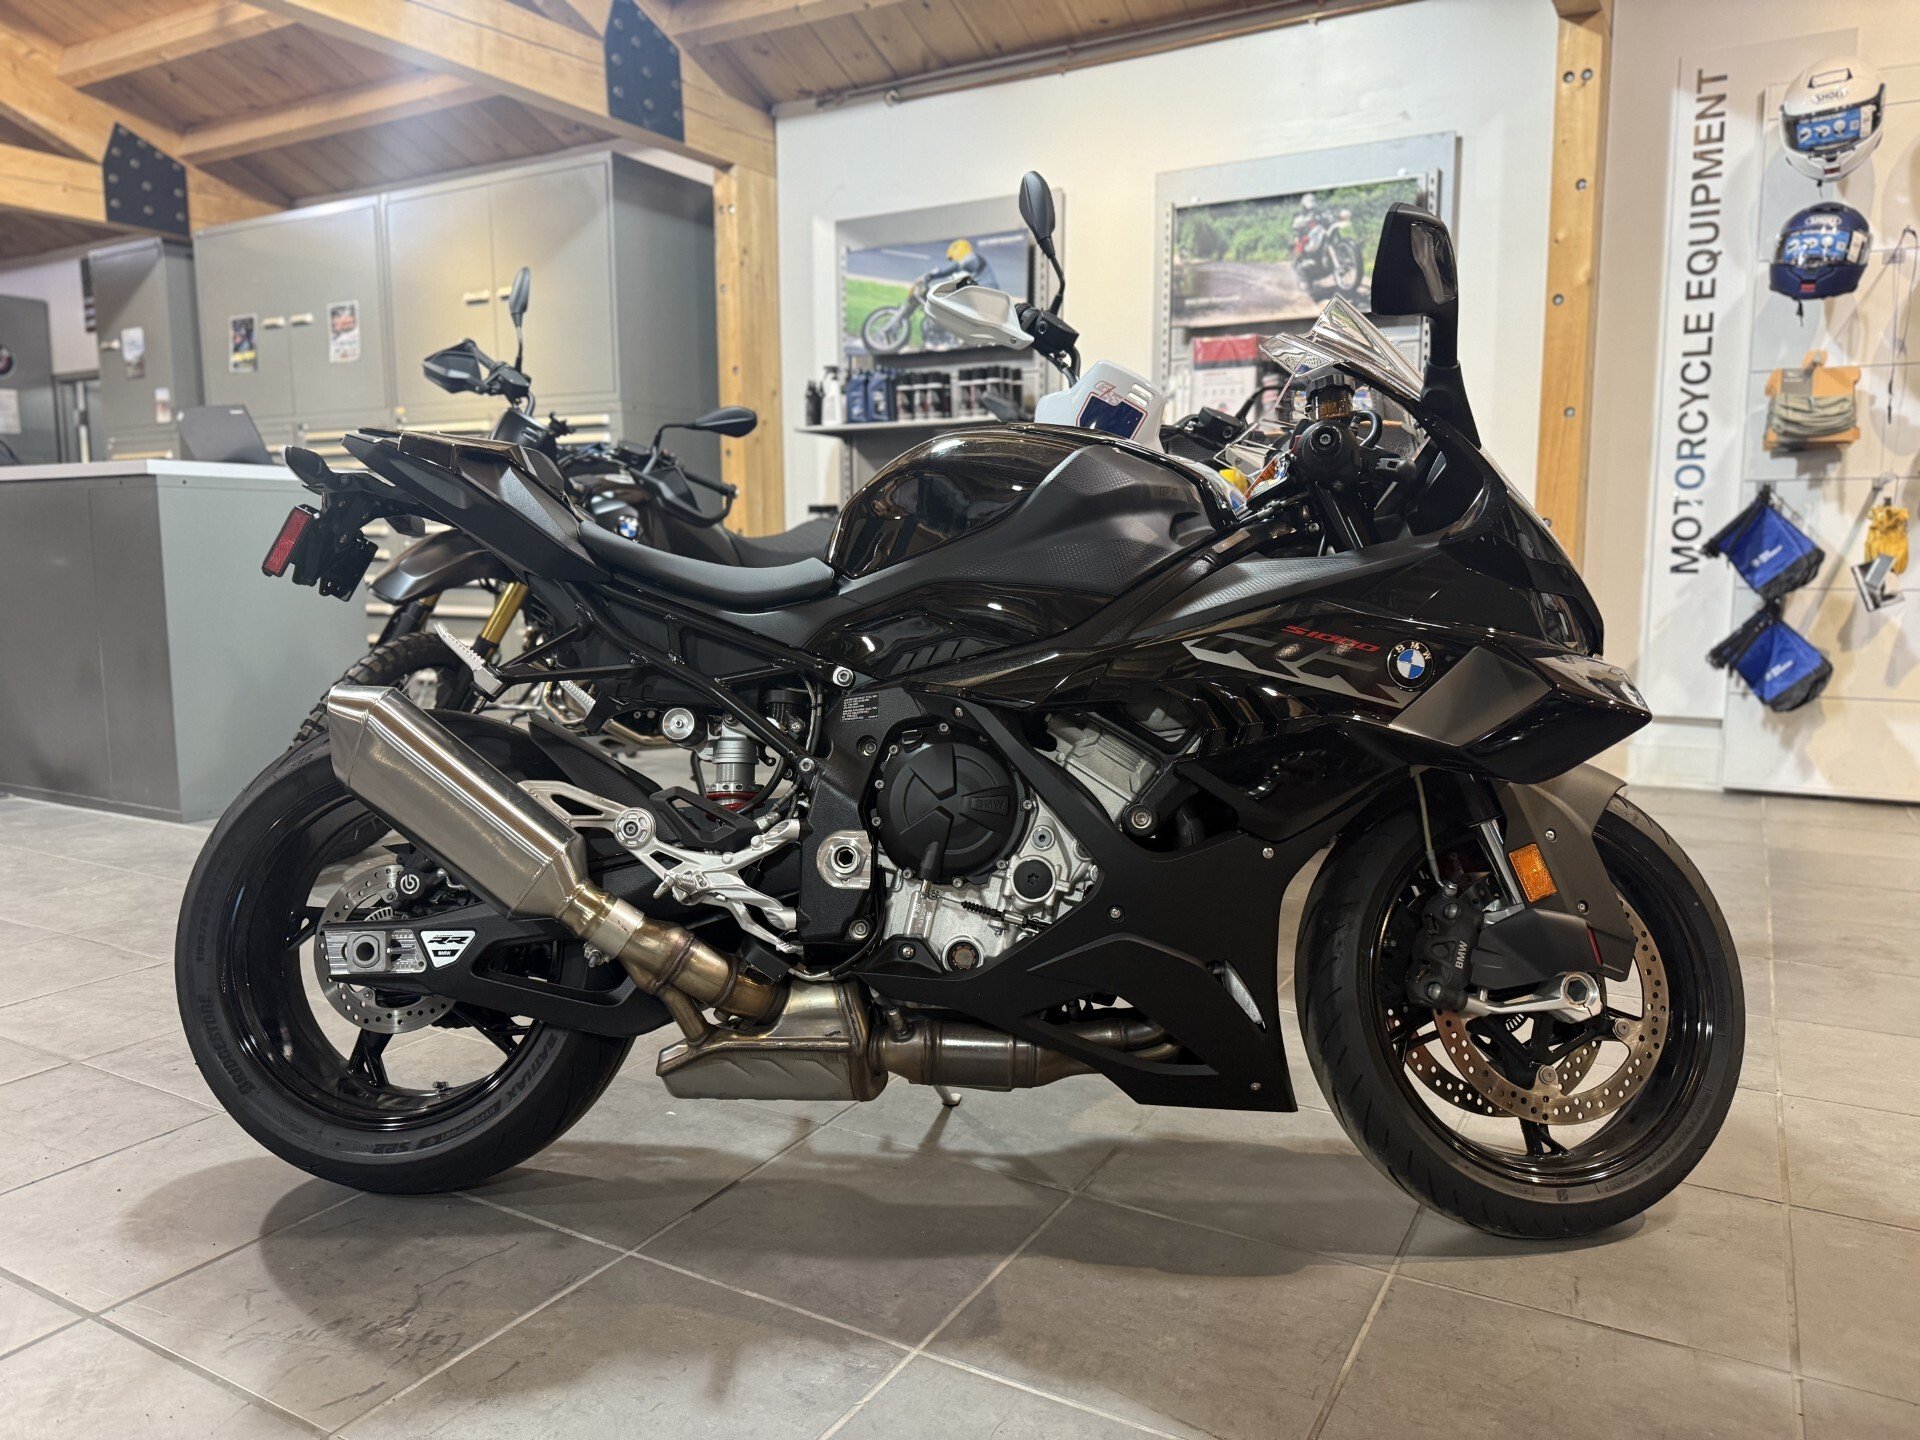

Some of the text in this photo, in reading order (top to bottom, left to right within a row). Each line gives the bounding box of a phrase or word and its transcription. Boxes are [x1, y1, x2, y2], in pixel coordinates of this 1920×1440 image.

[1670, 69, 1728, 574] MOTORCYCLE EQUIPMENT
[1281, 624, 1380, 653] S1000
[1395, 641, 1432, 660] BMW
[976, 799, 1008, 809] BMW
[1455, 940, 1468, 970] BMW
[197, 994, 257, 1096] BRIDGESTONE
[506, 1031, 558, 1103] BATTLAX
